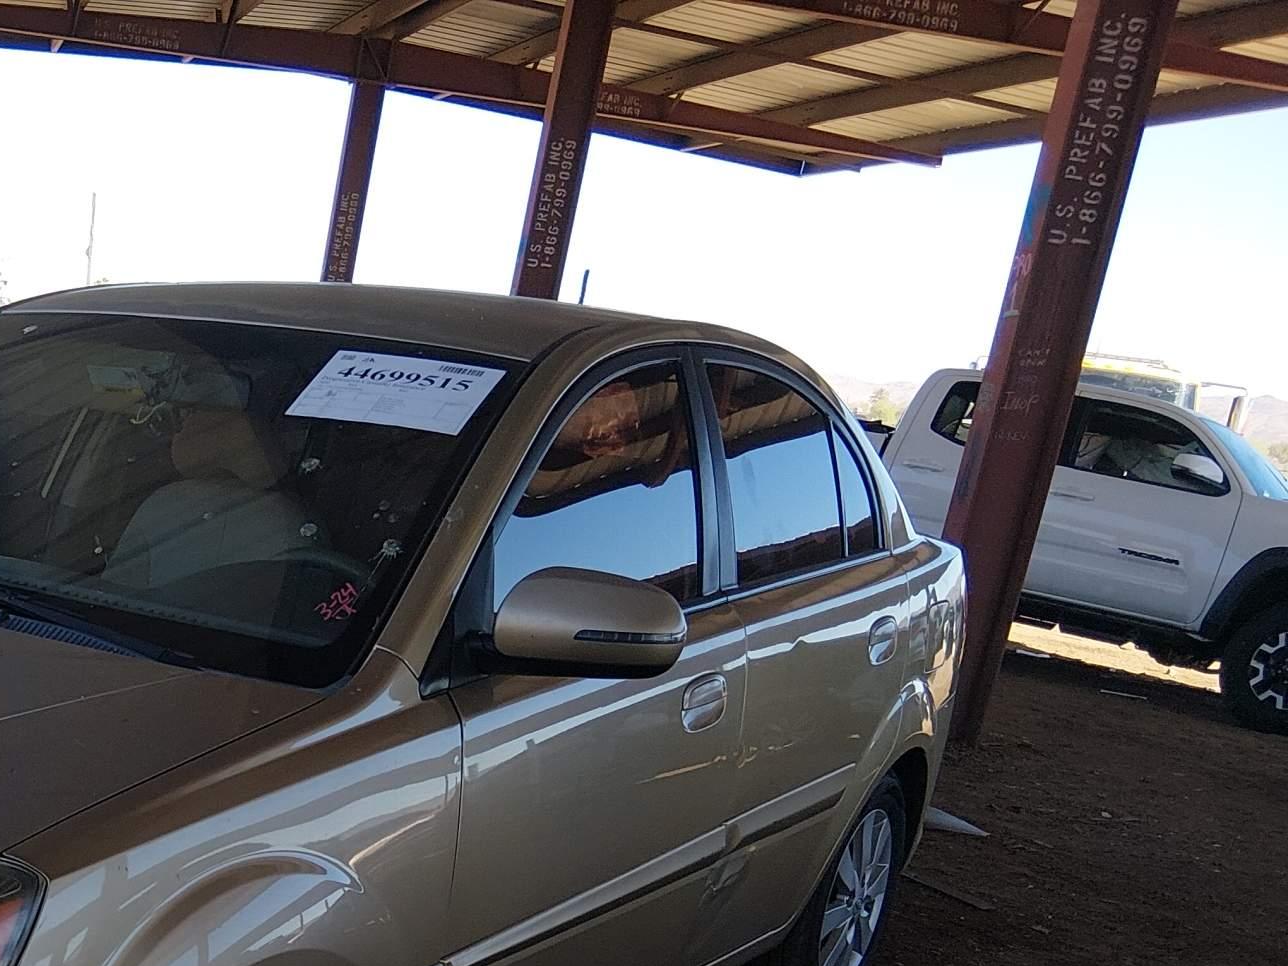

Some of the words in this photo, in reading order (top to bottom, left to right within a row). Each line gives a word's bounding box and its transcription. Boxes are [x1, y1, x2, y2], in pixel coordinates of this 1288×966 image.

[885, 0, 930, 11] REFAB
[1048, 197, 1078, 245] U.S.
[1065, 78, 1106, 181] PREFAB
[1095, 12, 1126, 63] INC.
[1071, 16, 1148, 246] 1-866-799-0969
[331, 216, 346, 257] PREFAB
[527, 240, 543, 268] U.S.
[535, 173, 556, 231] PREFAB
[548, 137, 564, 166] INC.
[540, 140, 577, 268] 1-866-799-0969
[337, 365, 473, 392] 44699515
[1118, 547, 1180, 566] TACOMA
